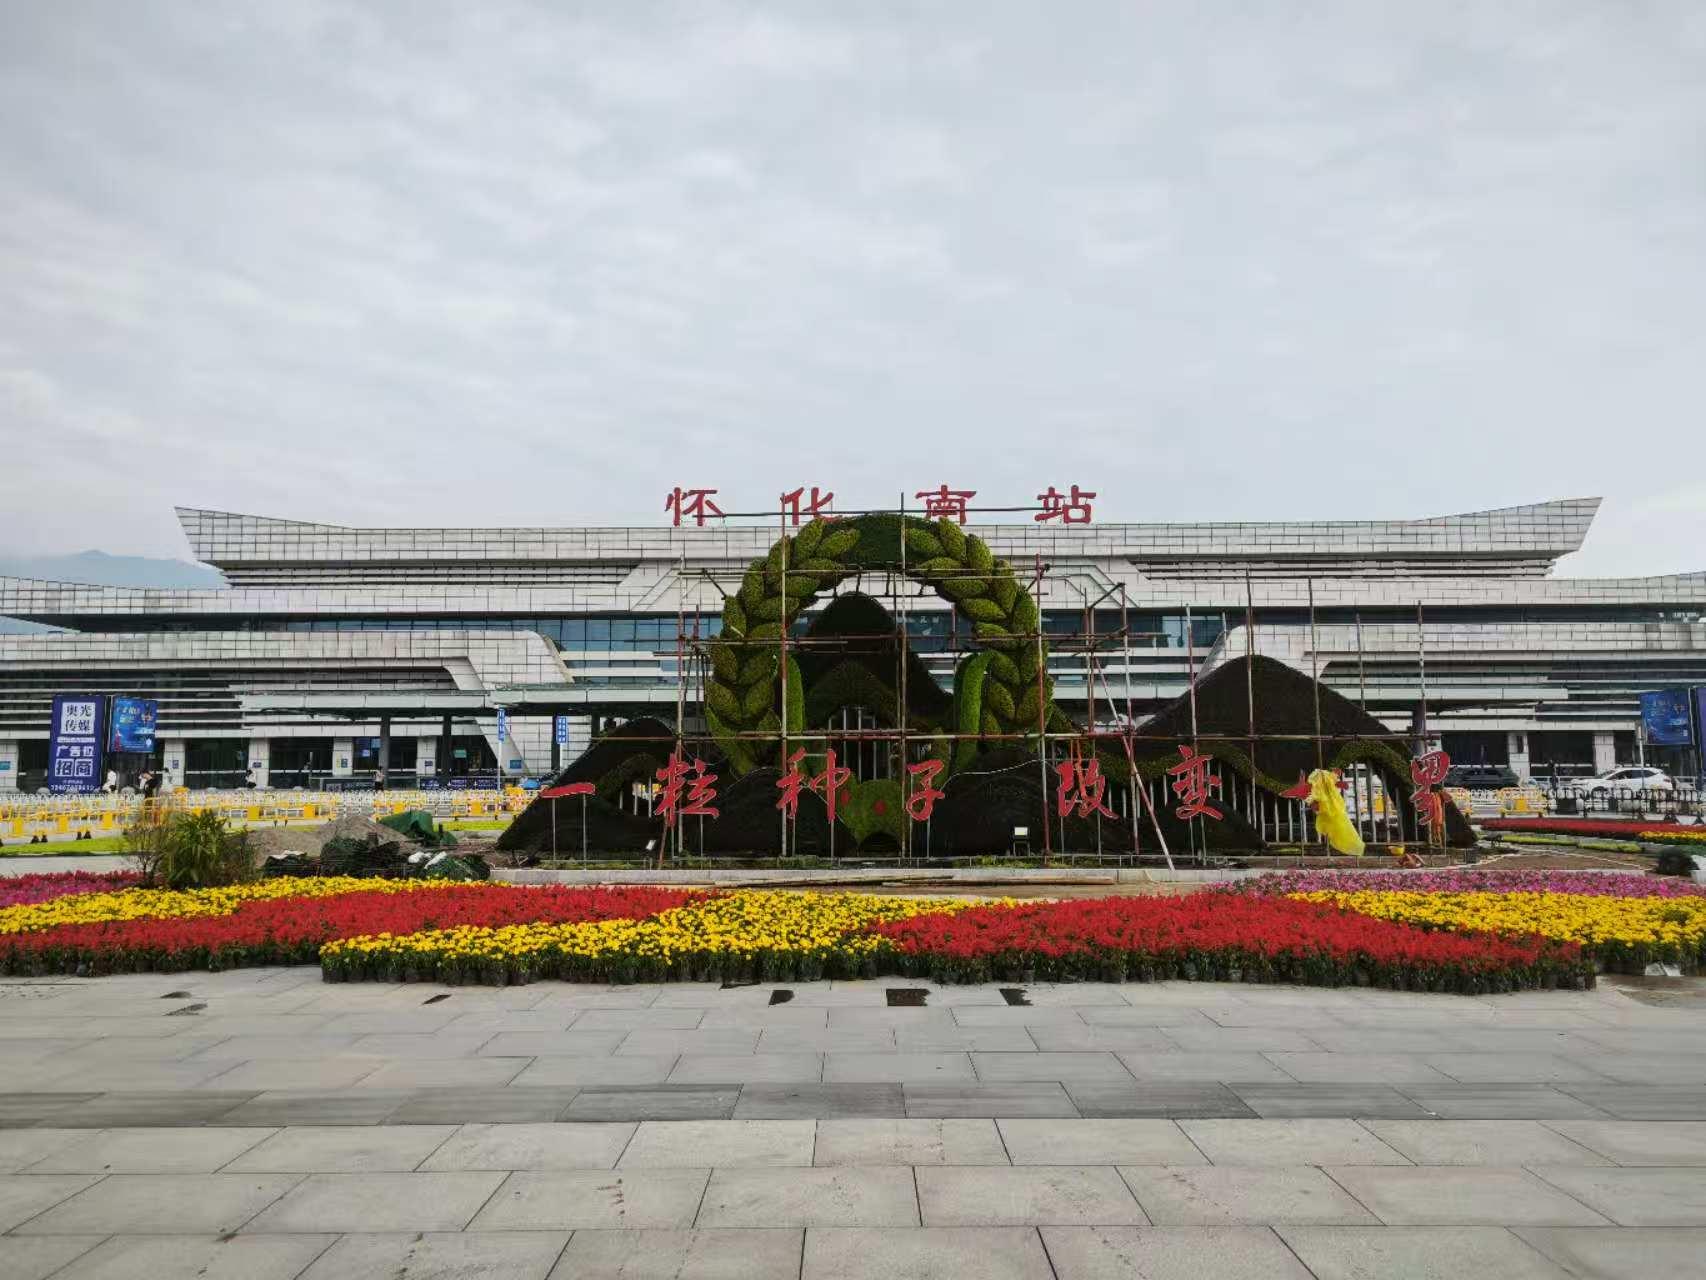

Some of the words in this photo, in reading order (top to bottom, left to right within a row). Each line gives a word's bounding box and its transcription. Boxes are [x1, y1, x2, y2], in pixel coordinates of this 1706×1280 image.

[665, 485, 1096, 527] 怀化南站
[65, 719, 91, 732] 传媒
[56, 745, 95, 757] 广告位
[56, 758, 93, 777] 招商
